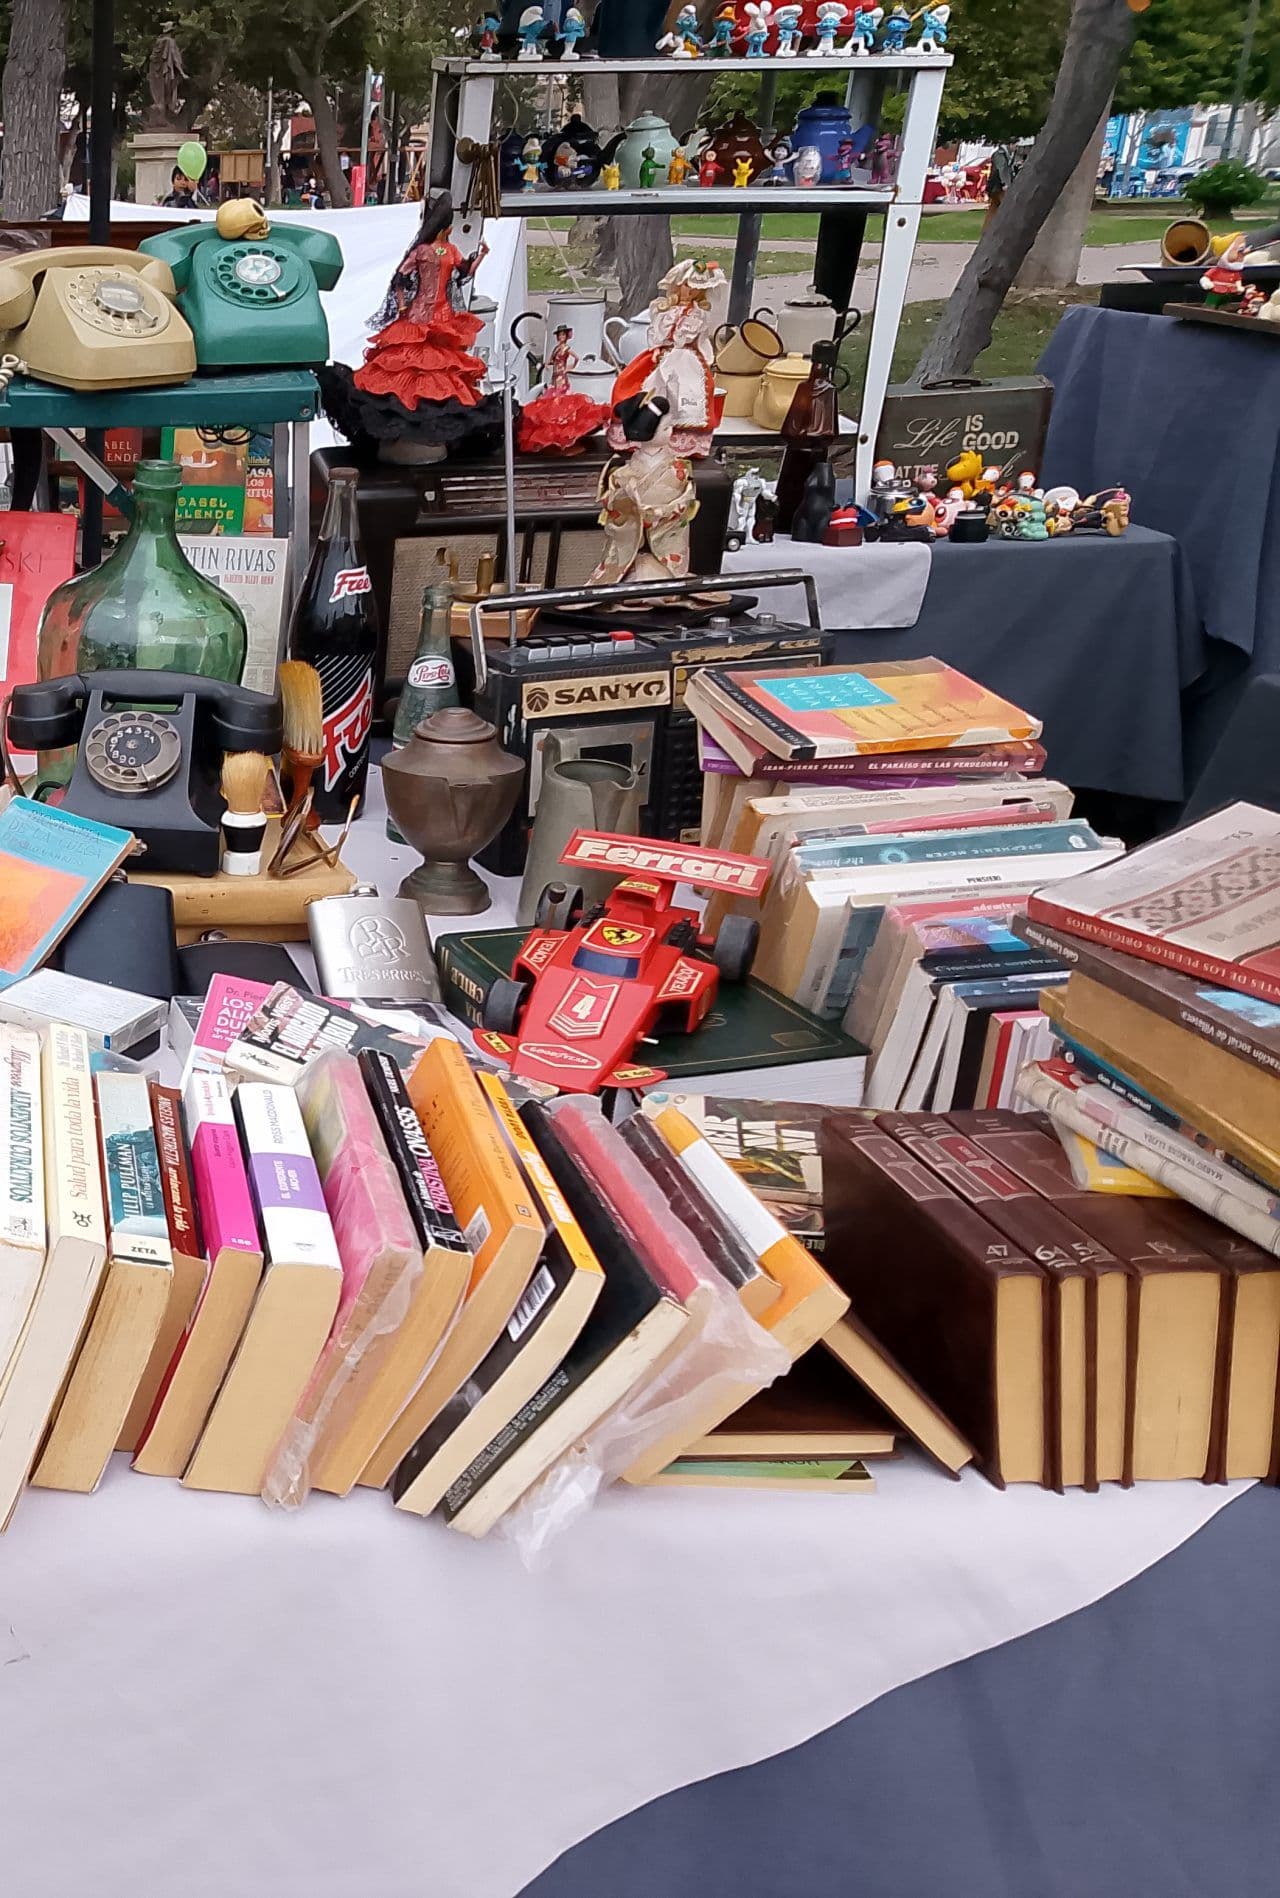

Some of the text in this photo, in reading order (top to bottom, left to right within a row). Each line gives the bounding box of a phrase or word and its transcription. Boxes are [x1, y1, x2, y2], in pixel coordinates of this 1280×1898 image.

[965, 414, 984, 432] IS
[893, 417, 961, 456] Life
[962, 431, 1019, 451] GOOD
[894, 466, 913, 479] AT
[225, 548, 276, 573] RIVAS
[334, 572, 370, 596] Free
[554, 680, 667, 705] SANYO
[921, 761, 932, 769] DE
[934, 761, 950, 769] LAS
[574, 841, 760, 886] Ferrari
[1145, 943, 1200, 968] PUEBLOS
[1202, 962, 1227, 979] LOS
[1229, 971, 1248, 985] DE
[225, 987, 240, 995] Dr.
[451, 967, 484, 1004] CHILE
[672, 964, 698, 995] TEXACO
[222, 997, 253, 1010] LOS
[571, 995, 595, 1020] 4
[1215, 1027, 1253, 1053] de social
[529, 1046, 590, 1065] GOODYEAR
[64, 1077, 81, 1097] vida
[64, 1095, 81, 1110] la
[64, 1110, 84, 1138] toda
[69, 1138, 91, 1171] para
[158, 1123, 181, 1167] MASTRETTA
[115, 1142, 139, 1191] PULLMAN
[394, 1104, 454, 1215] CHRISTINA ONASSIS
[1170, 1147, 1203, 1169] VARGAS
[70, 1169, 87, 1200] Salud
[1201, 1164, 1225, 1182] MARIO
[131, 1246, 158, 1256] ZETA
[987, 1244, 1009, 1258] 47
